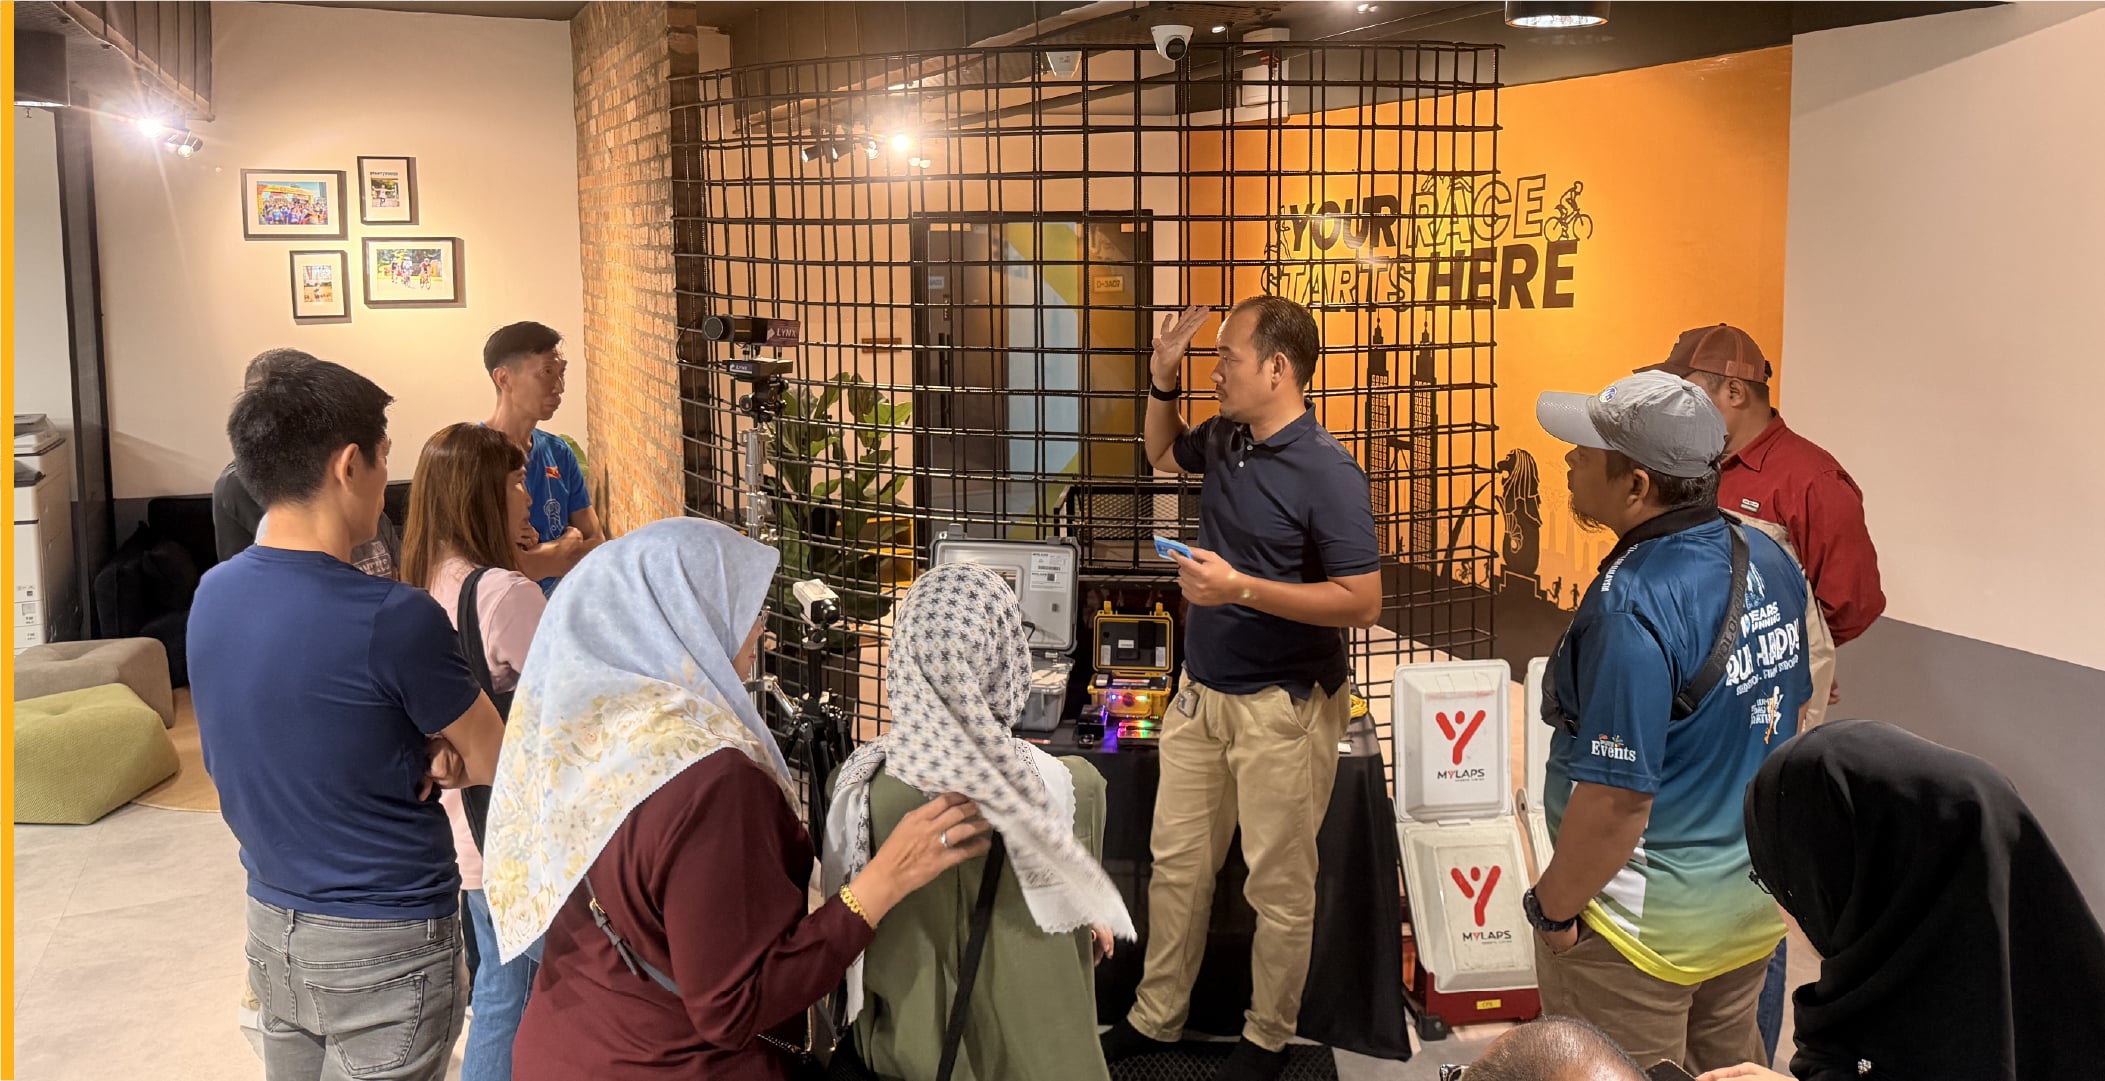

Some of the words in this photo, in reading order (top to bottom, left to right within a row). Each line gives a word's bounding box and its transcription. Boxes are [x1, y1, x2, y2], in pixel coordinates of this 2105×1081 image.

[1290, 195, 1399, 251] YOUR
[1406, 174, 1546, 248] RACE
[1261, 255, 1416, 311] STARTS
[1425, 239, 1578, 311] HERE
[776, 328, 797, 337] LYNX
[1591, 740, 1637, 763] Events
[1437, 769, 1485, 779] MYLAPS
[1462, 930, 1512, 942] MYLAPS
